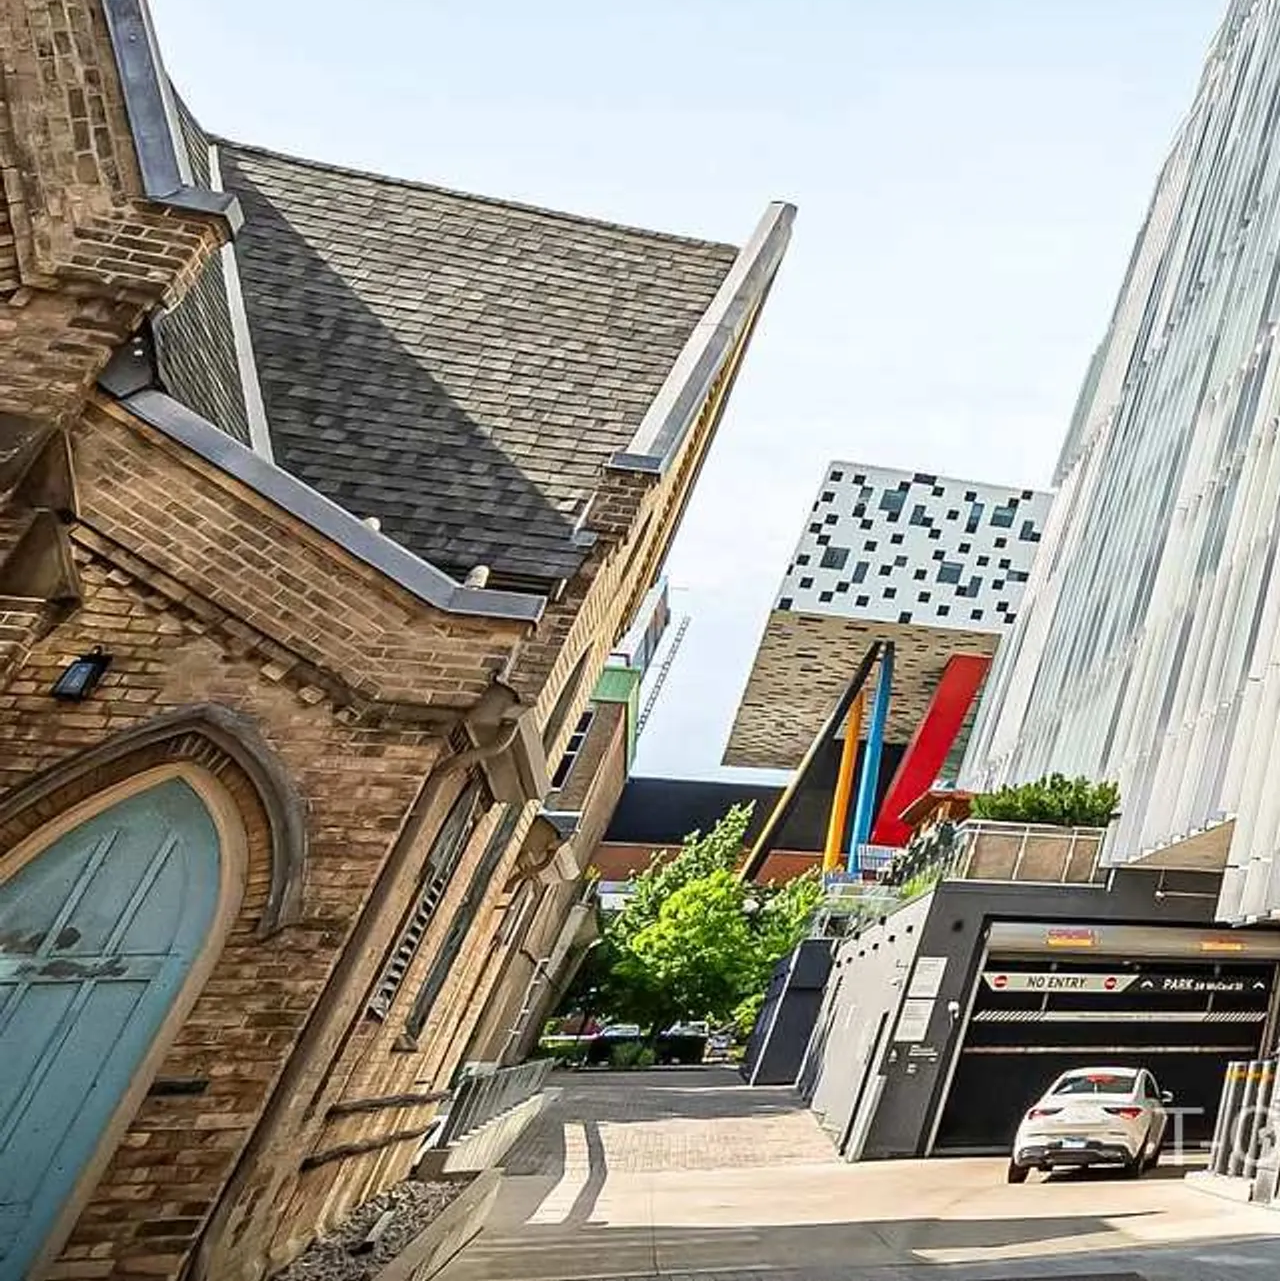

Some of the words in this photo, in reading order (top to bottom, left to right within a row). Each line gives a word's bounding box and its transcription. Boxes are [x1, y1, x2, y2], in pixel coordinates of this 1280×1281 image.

[1026, 975, 1046, 989] NO
[1047, 975, 1088, 989] ENTRY
[1162, 978, 1194, 991] PARK
